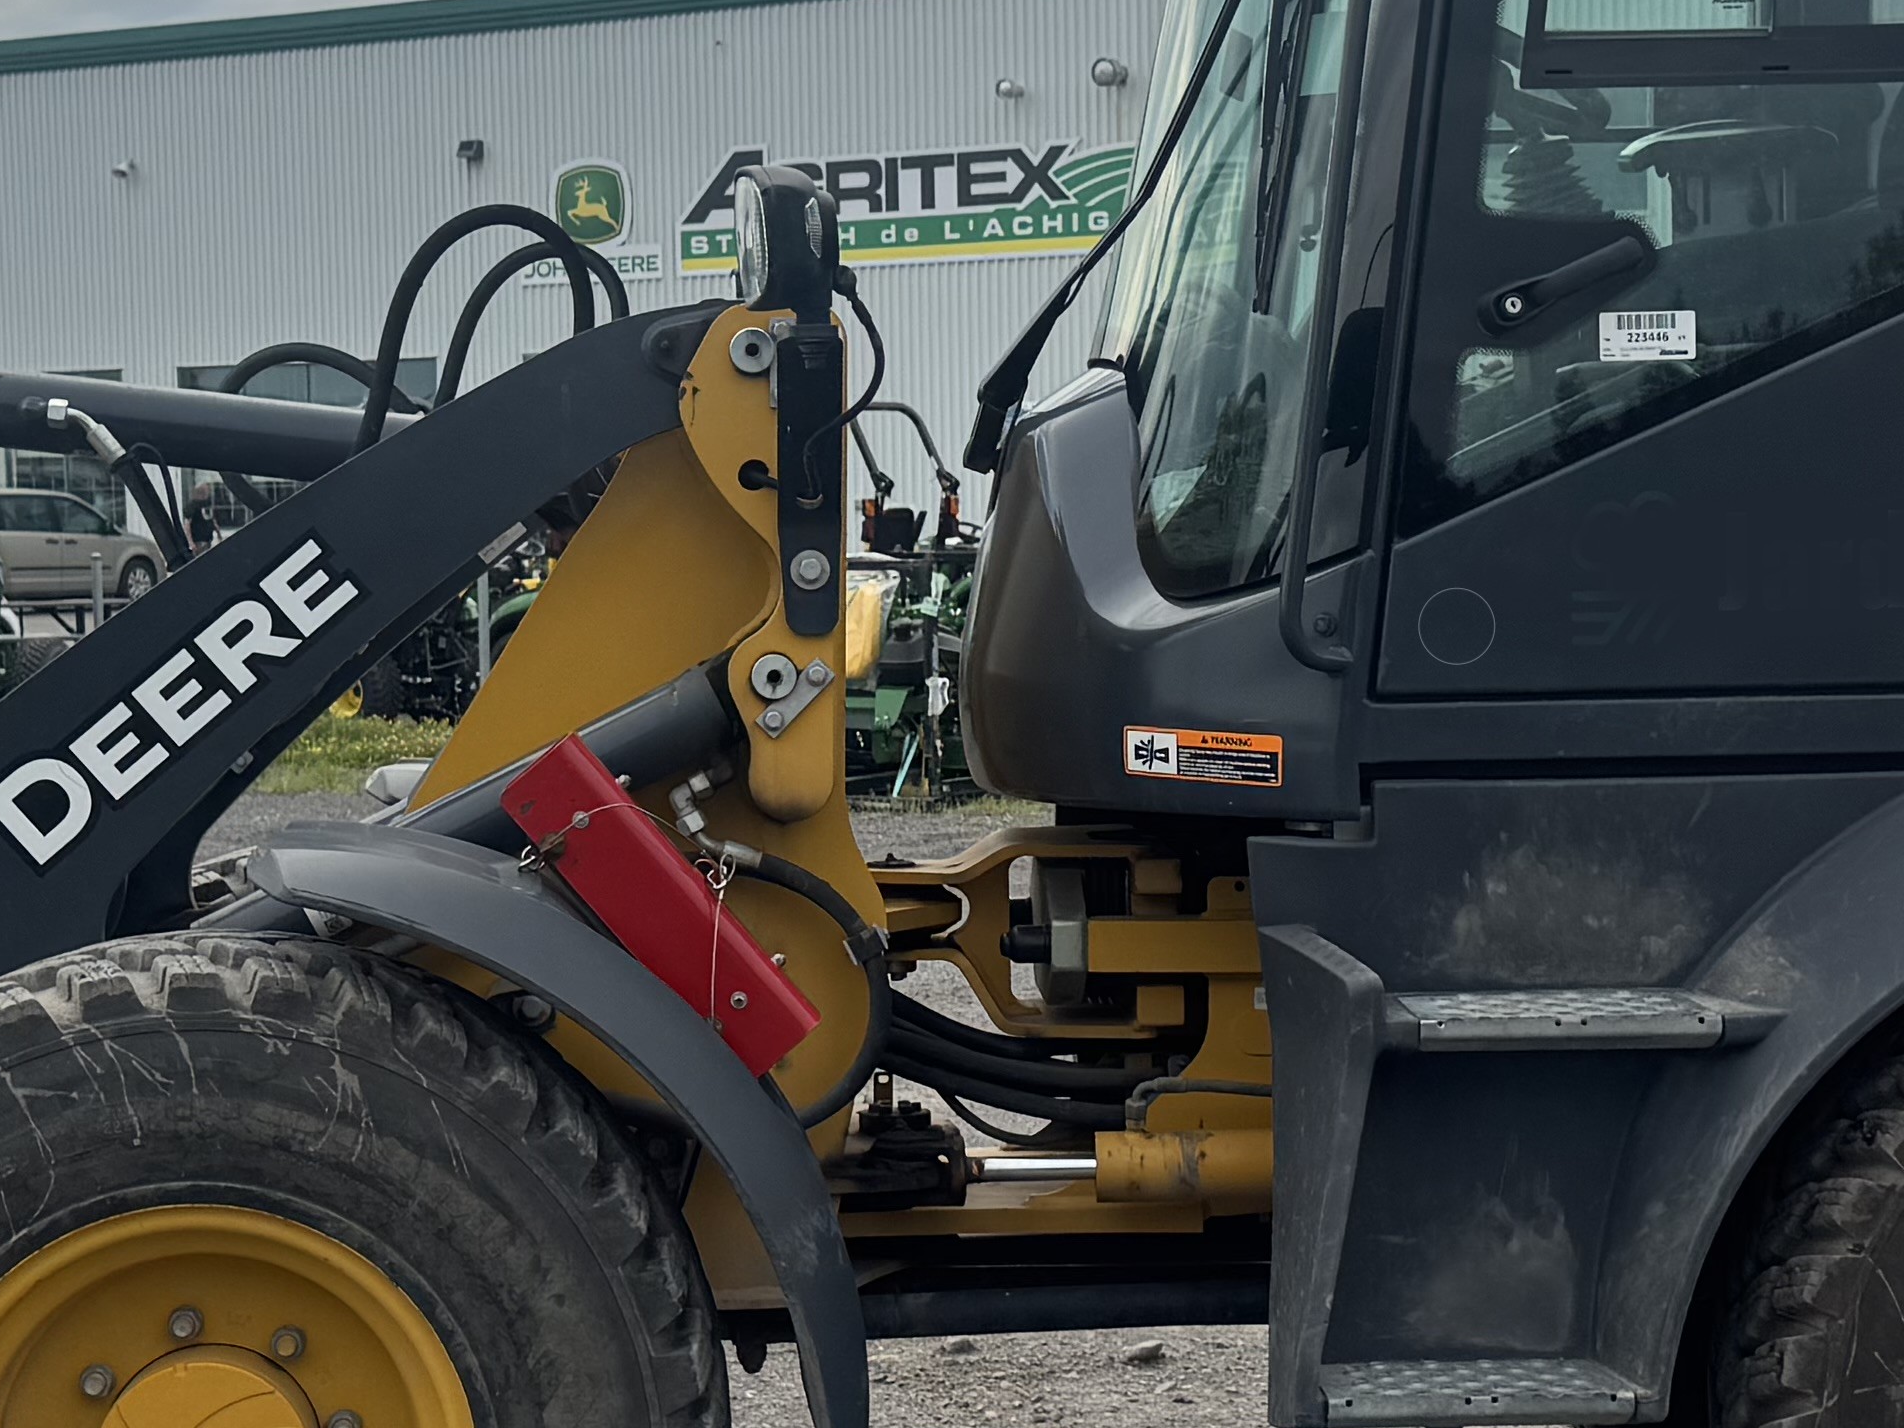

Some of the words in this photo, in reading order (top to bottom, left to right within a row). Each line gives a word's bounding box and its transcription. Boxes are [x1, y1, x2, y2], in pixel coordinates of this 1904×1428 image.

[881, 224, 919, 244] de
[943, 210, 1111, 241] L'ACHIG
[524, 260, 566, 279] JOH
[606, 254, 660, 274] ERE
